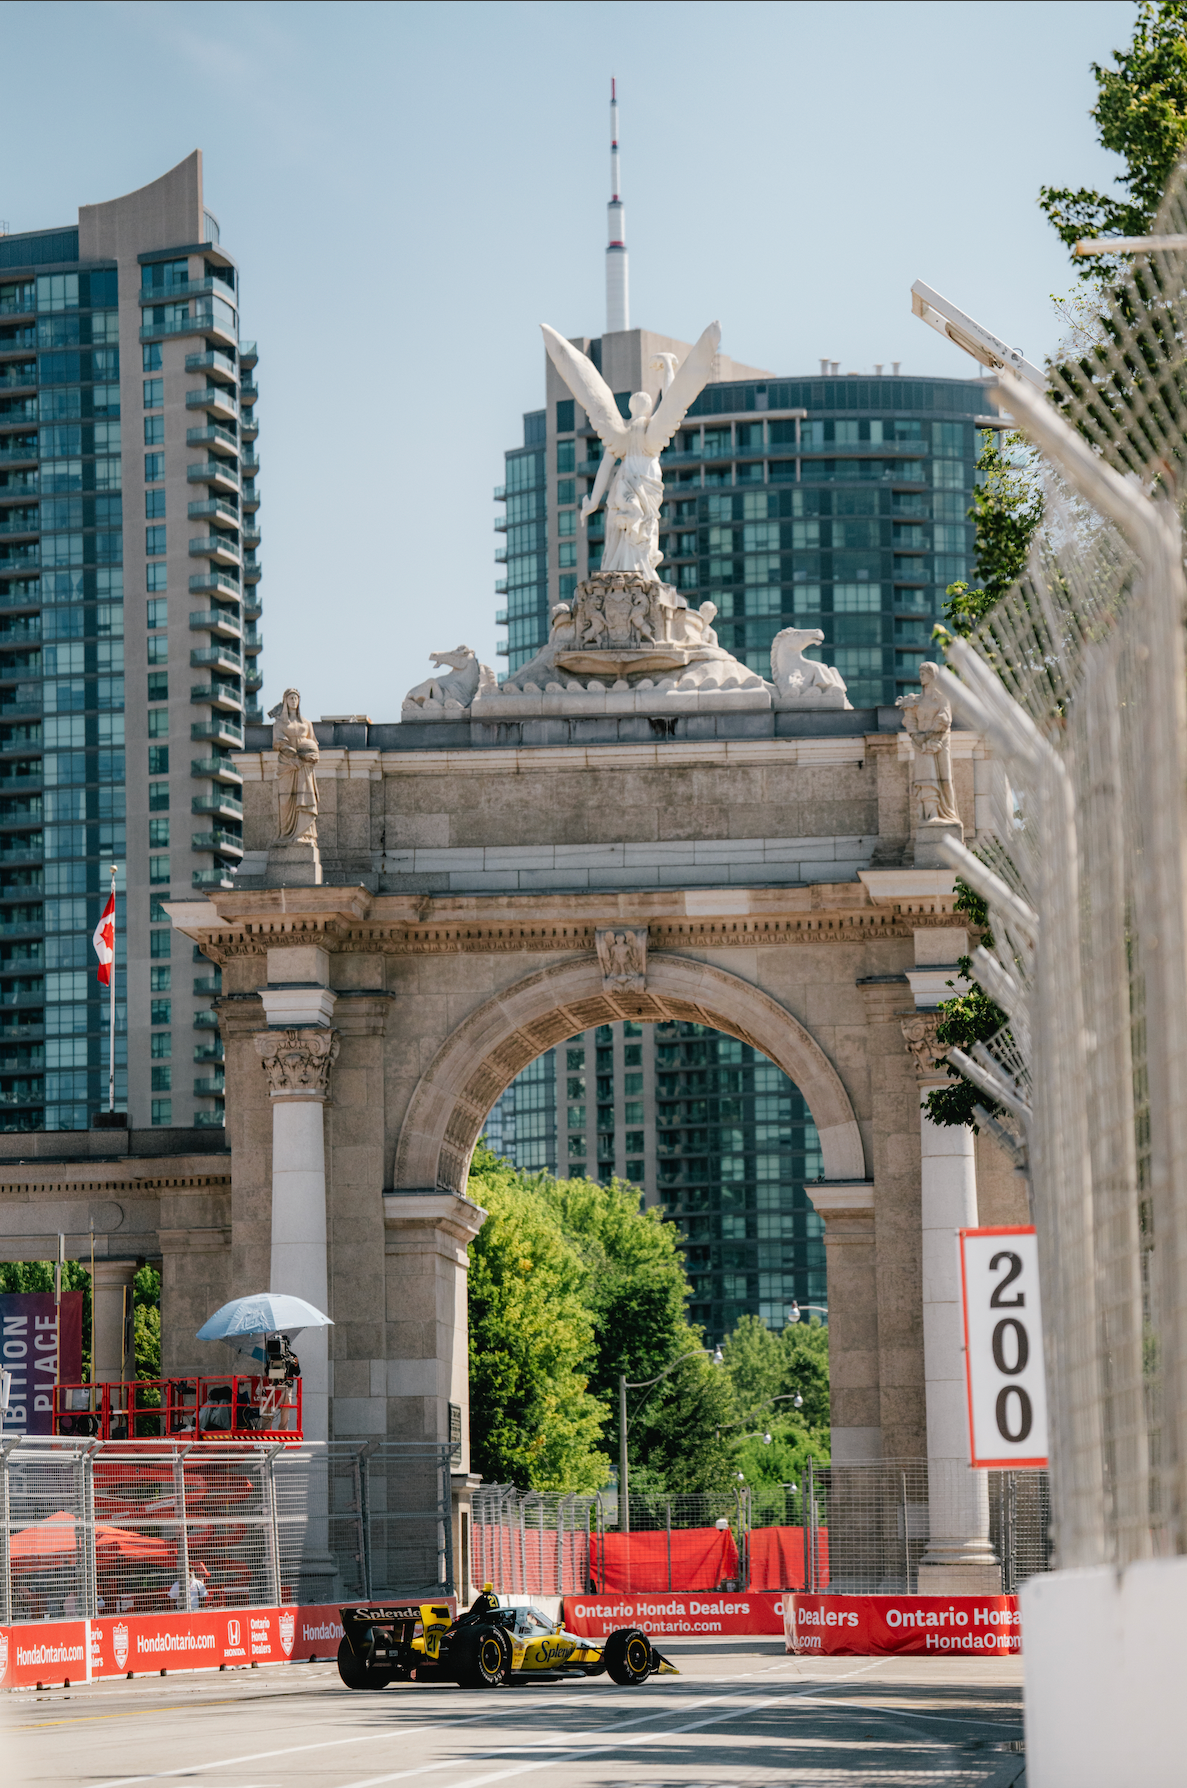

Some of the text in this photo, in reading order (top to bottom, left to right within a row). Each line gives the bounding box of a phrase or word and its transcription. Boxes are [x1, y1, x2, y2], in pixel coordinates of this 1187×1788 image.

[988, 1251, 1033, 1443] 200
[34, 1315, 58, 1412] PLACE
[487, 1595, 499, 1607] 21
[575, 1600, 750, 1618] Ontario Honda Dealers
[250, 1617, 270, 1630] Ontario
[798, 1606, 859, 1627] Dealers
[886, 1606, 969, 1627] Ontario
[136, 1631, 216, 1653] HondaOntario.com
[251, 1629, 268, 1643] Honda
[427, 1634, 437, 1652] 21
[16, 1642, 84, 1666] HondaOntario.com
[224, 1647, 247, 1658] HONDA
[251, 1642, 272, 1655] Dealers
